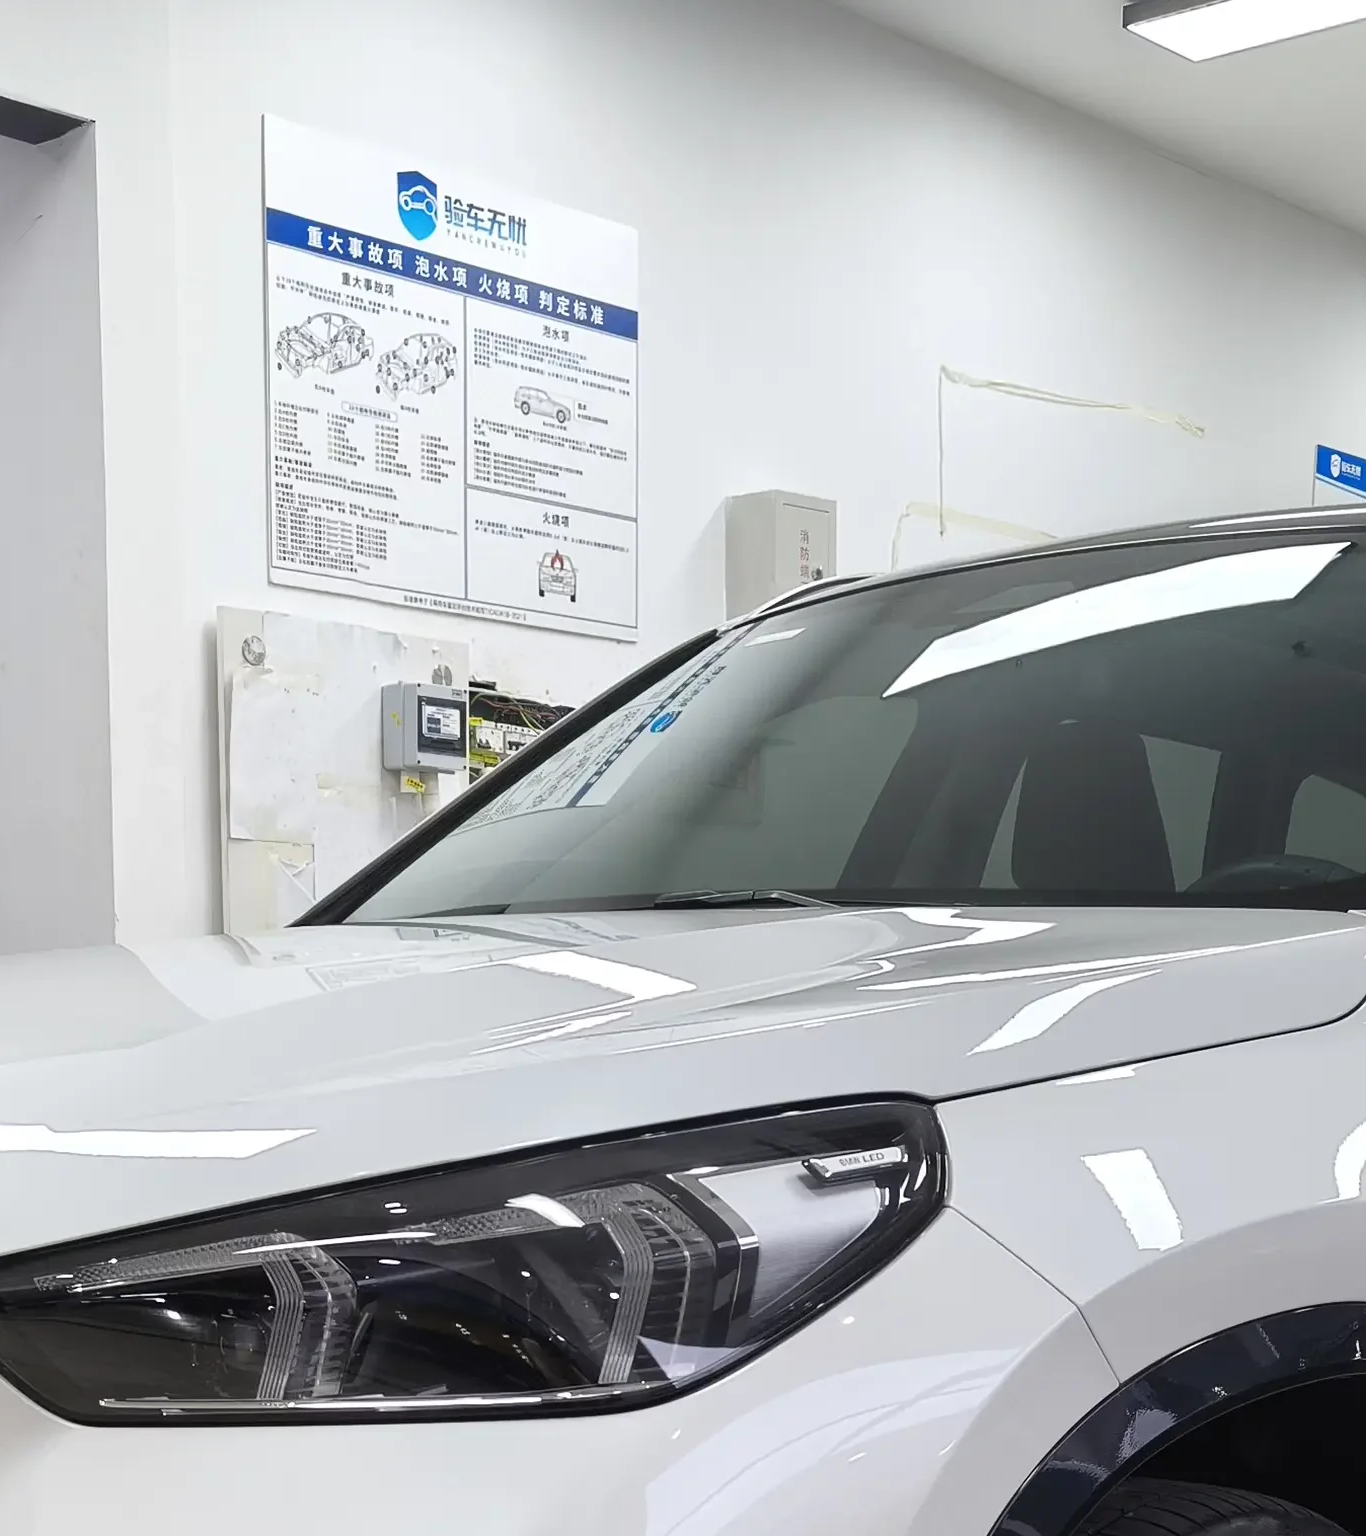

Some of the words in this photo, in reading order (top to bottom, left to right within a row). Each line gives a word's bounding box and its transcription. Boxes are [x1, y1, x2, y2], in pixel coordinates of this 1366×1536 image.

[444, 195, 527, 246] 验车无忧
[306, 225, 404, 271] 重大事故项
[415, 254, 468, 289] 泡水项
[478, 273, 529, 305] 火烧项
[538, 290, 605, 326] 判定标准
[341, 271, 395, 298] 重大事故项
[542, 324, 570, 343] 泡水项
[542, 511, 570, 529] 火烧项
[863, 1152, 885, 1164] LED
